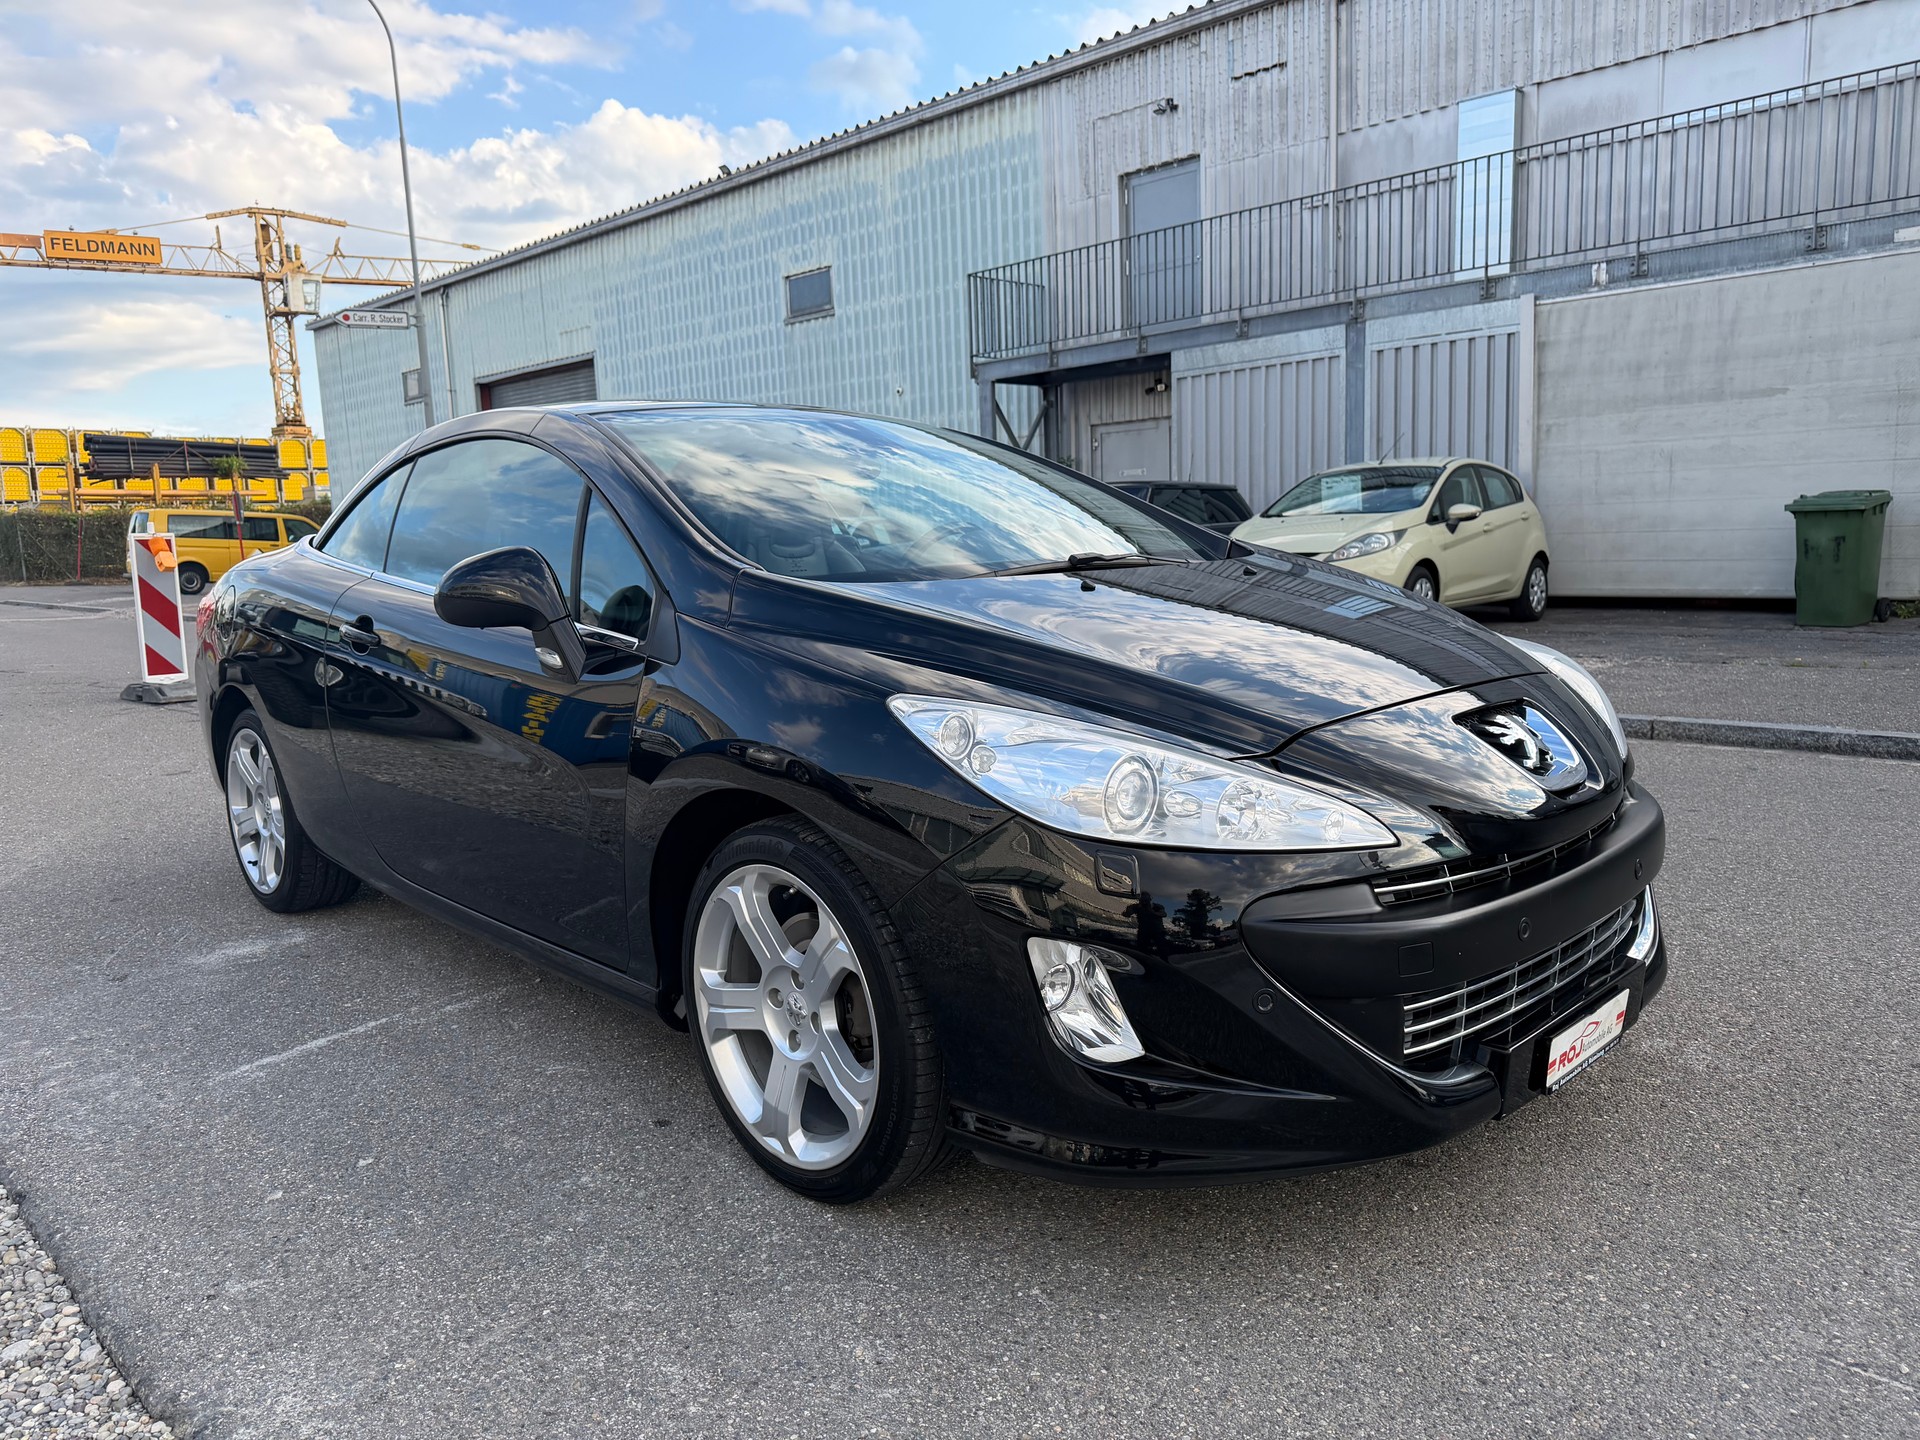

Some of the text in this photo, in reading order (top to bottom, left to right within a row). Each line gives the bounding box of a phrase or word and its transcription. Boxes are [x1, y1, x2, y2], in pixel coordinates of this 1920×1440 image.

[50, 237, 155, 256] FELDMANN
[353, 313, 403, 324] Carr. R. Stocker
[1558, 1038, 1583, 1071] ROJ
